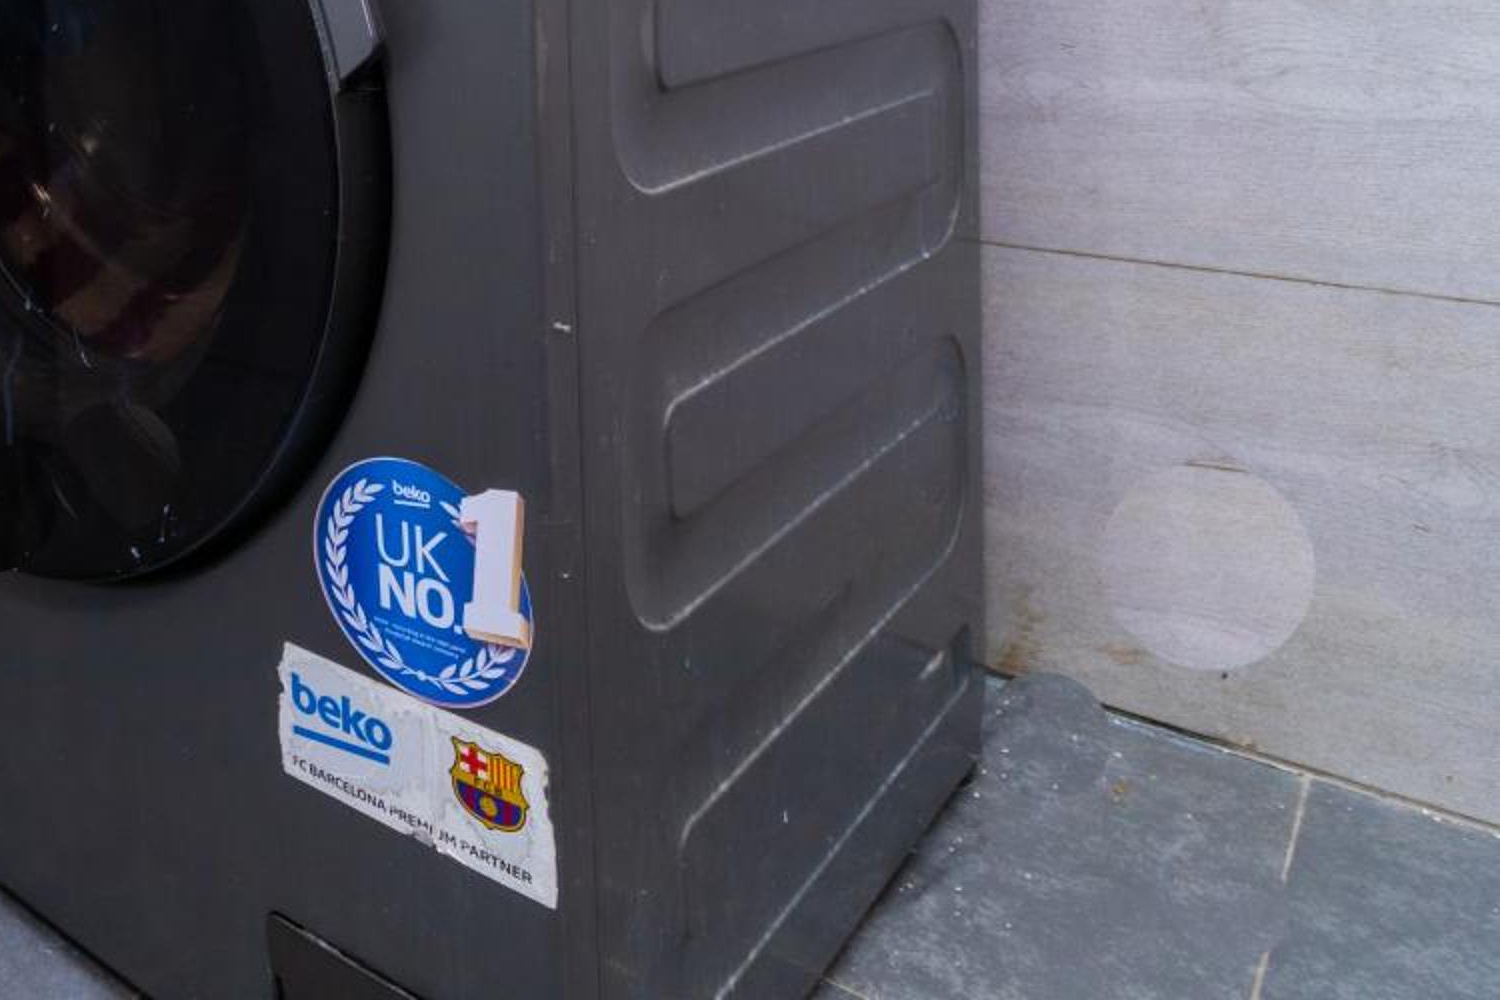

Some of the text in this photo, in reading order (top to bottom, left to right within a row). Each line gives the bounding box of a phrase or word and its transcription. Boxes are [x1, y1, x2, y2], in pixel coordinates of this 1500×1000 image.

[391, 479, 431, 504] beko
[375, 512, 449, 583] UK
[377, 562, 464, 634] NO.
[290, 670, 394, 752] beko
[309, 763, 388, 813] BARCELONA
[459, 839, 533, 884] PARTNER
